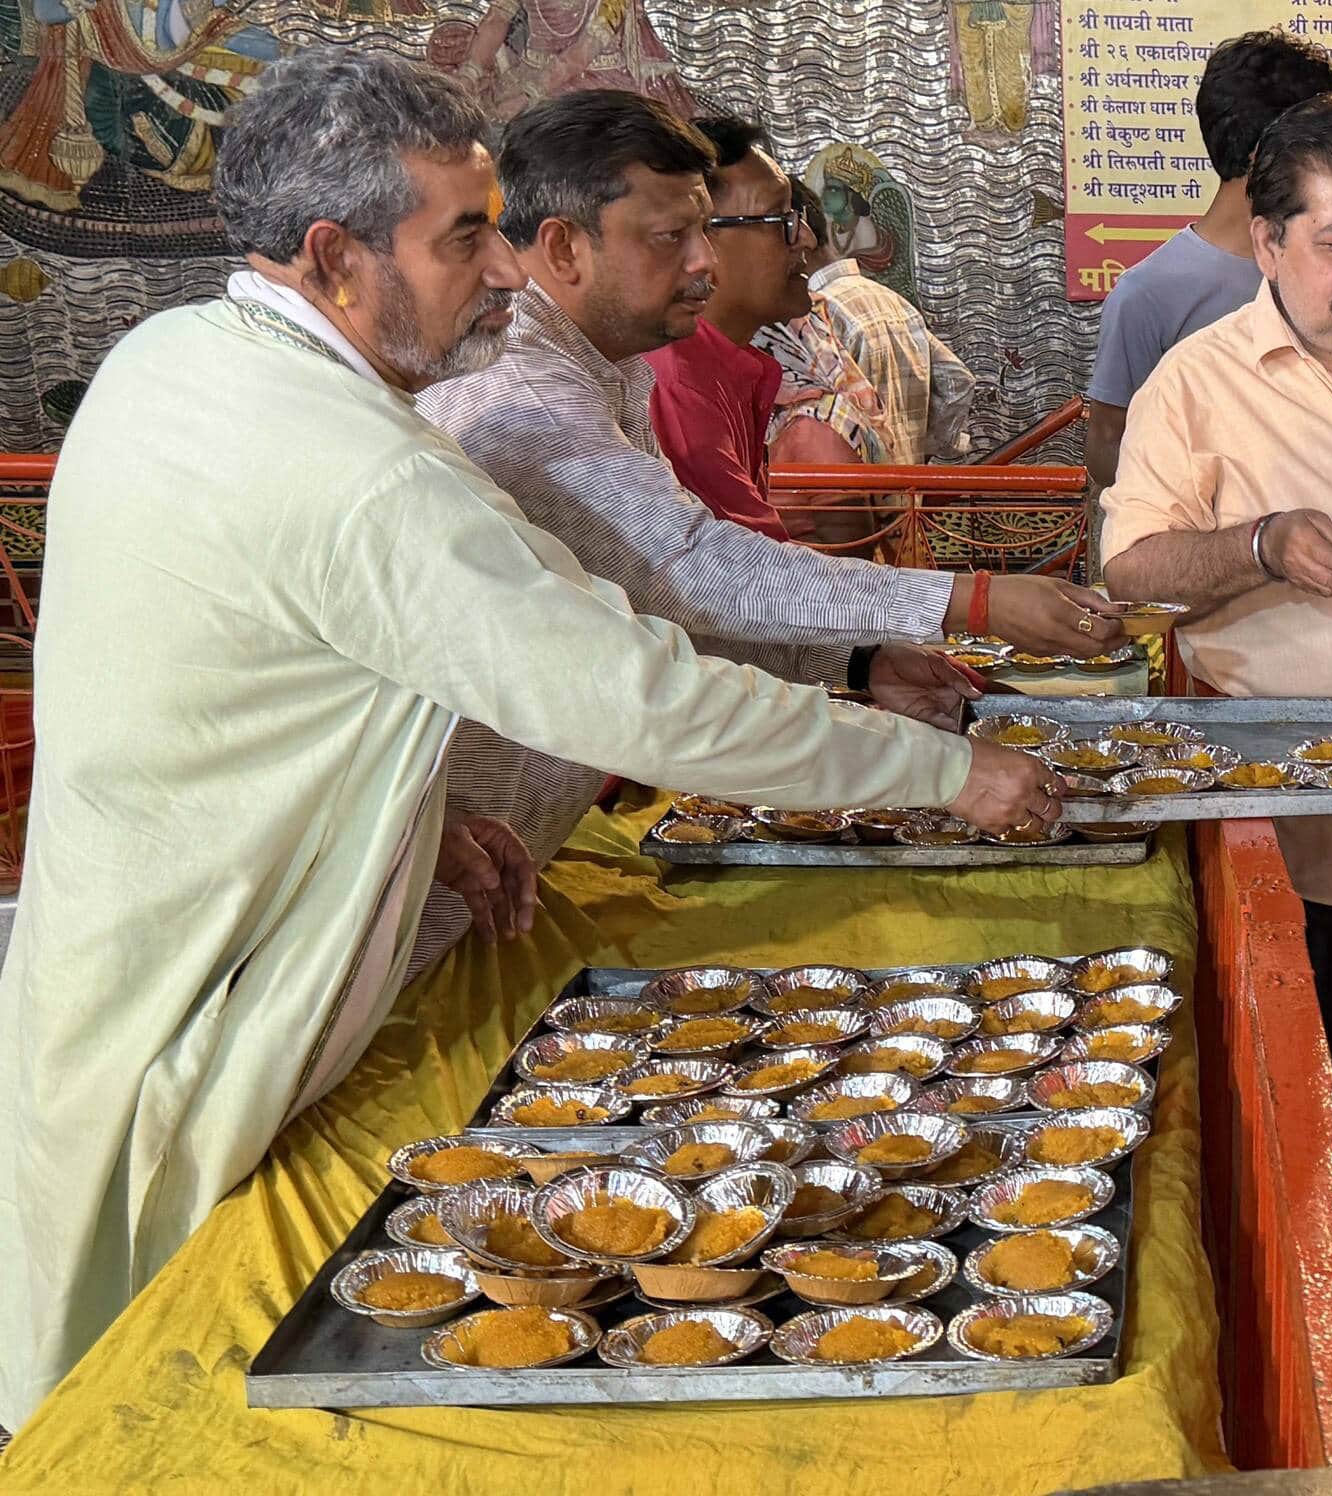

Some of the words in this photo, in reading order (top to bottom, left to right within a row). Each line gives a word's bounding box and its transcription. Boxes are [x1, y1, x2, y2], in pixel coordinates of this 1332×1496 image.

[1079, 8, 1099, 30] श्री
[1104, 10, 1152, 31] गायत्री
[1156, 16, 1194, 32] माता
[1289, 14, 1308, 35] श्री
[1080, 37, 1100, 58] श्री
[1107, 44, 1129, 61] २६
[1080, 67, 1100, 87] श्री
[1081, 95, 1099, 113] श्री
[1081, 121, 1101, 141] श्री
[1155, 128, 1185, 142] धाम
[1083, 149, 1103, 169] श्री
[1083, 177, 1103, 197] श्री
[1108, 183, 1176, 204] खाटूश्याम
[1181, 179, 1201, 198] जी
